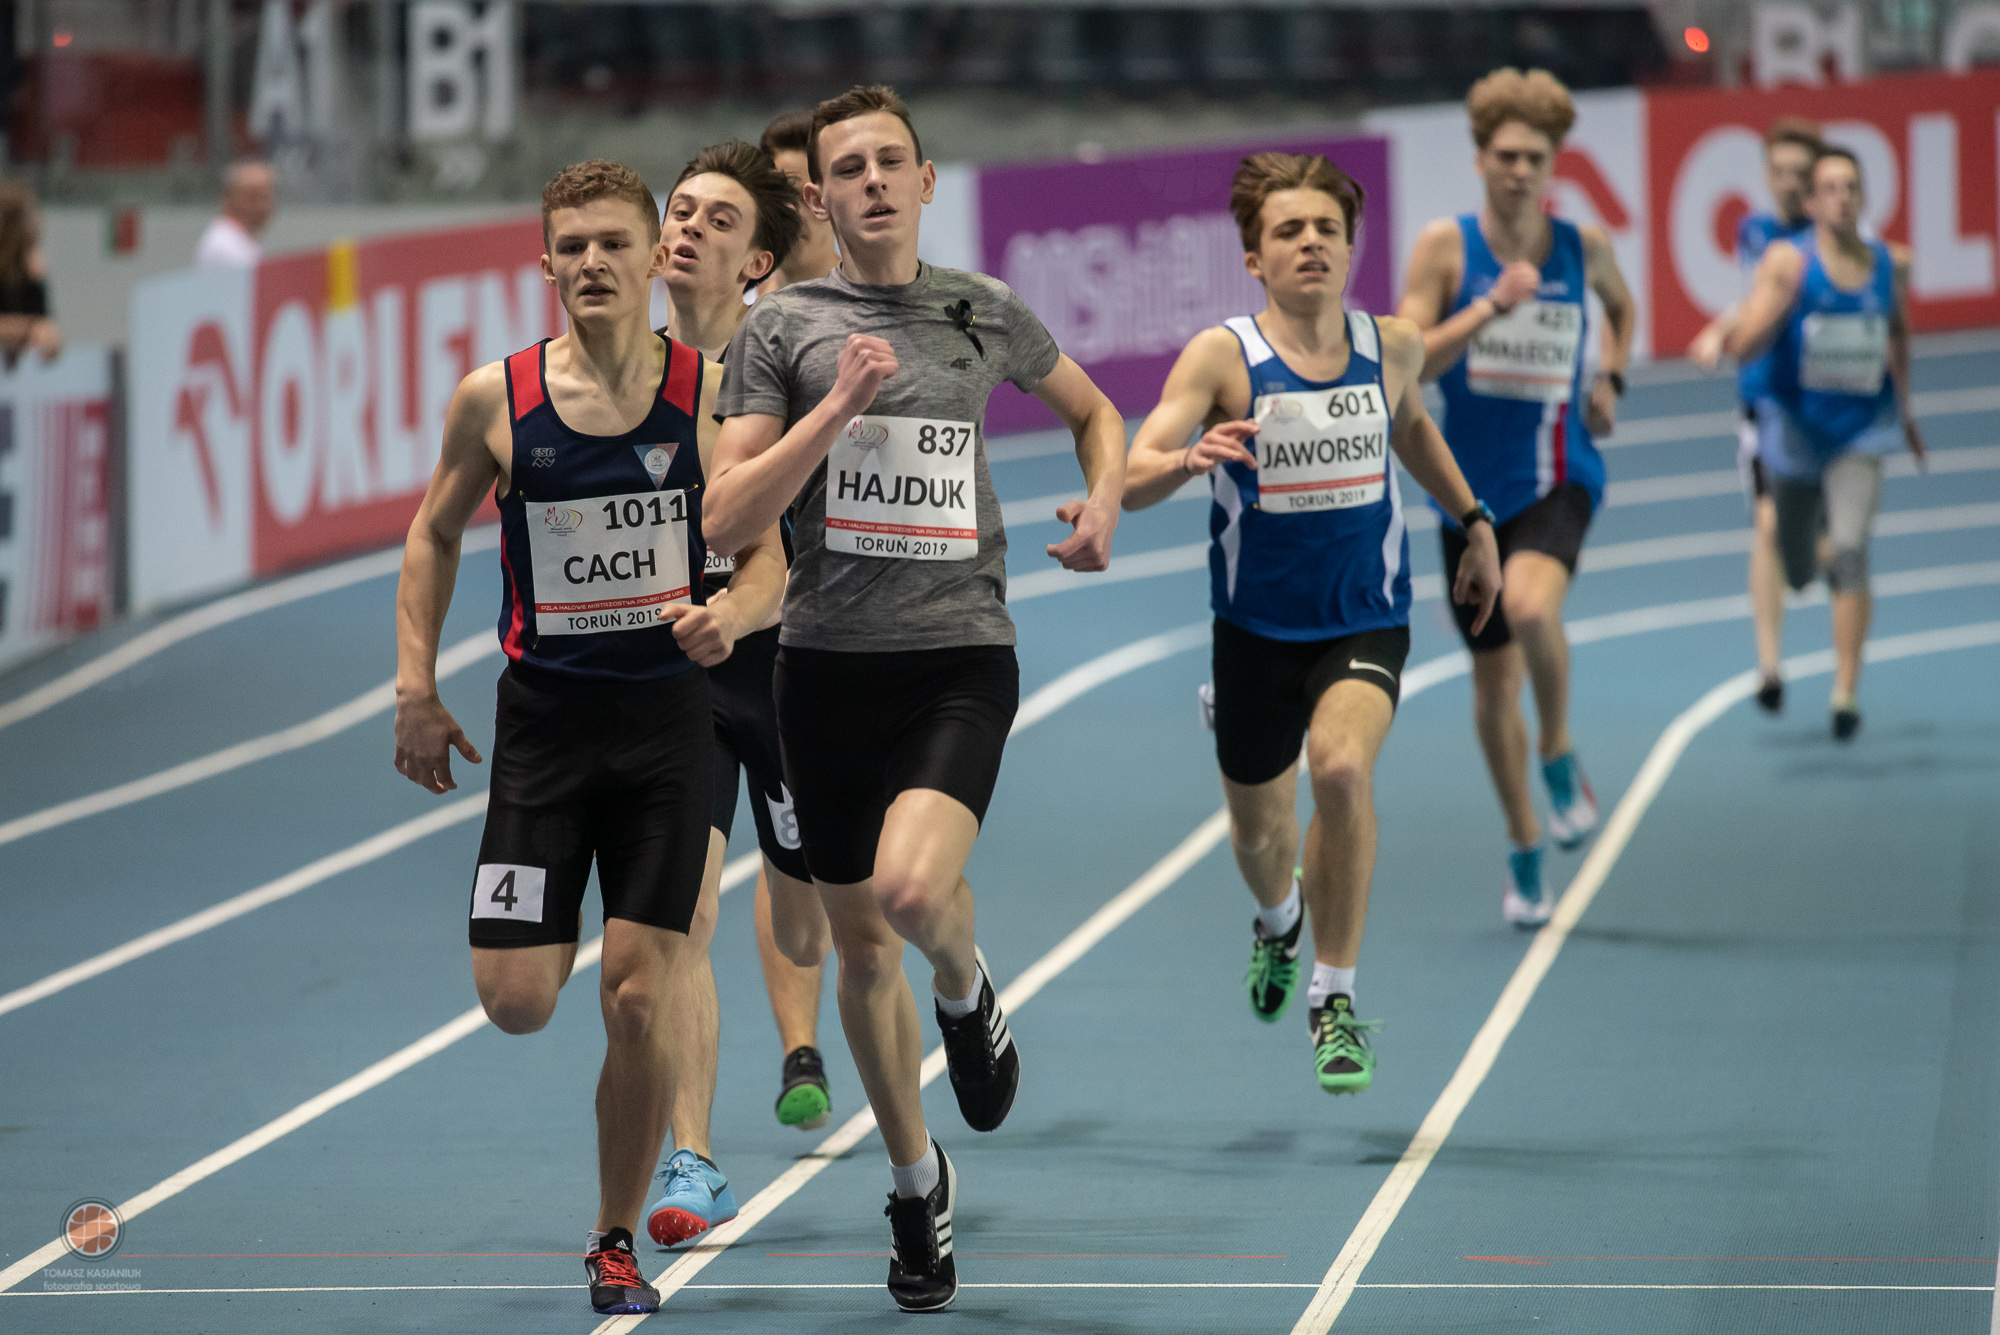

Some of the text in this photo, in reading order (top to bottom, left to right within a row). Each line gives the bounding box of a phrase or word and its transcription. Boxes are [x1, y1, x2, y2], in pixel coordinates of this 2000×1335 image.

[408, 0, 514, 139] B1
[1667, 112, 2000, 318] OL
[1327, 391, 1378, 418] 601
[917, 424, 971, 456] 837
[1263, 433, 1383, 469] JAWORSKI
[838, 470, 966, 509] HAJDUK
[602, 494, 687, 530] 1011
[704, 553, 736, 568] 2019
[855, 536, 948, 556] TORUŃ 2019
[563, 548, 657, 585] CACH
[568, 608, 662, 630] TORUŃ 2019
[587, 600, 636, 609] MISTRZOSTWA
[637, 596, 660, 604] POLSKI
[490, 870, 518, 911] 4
